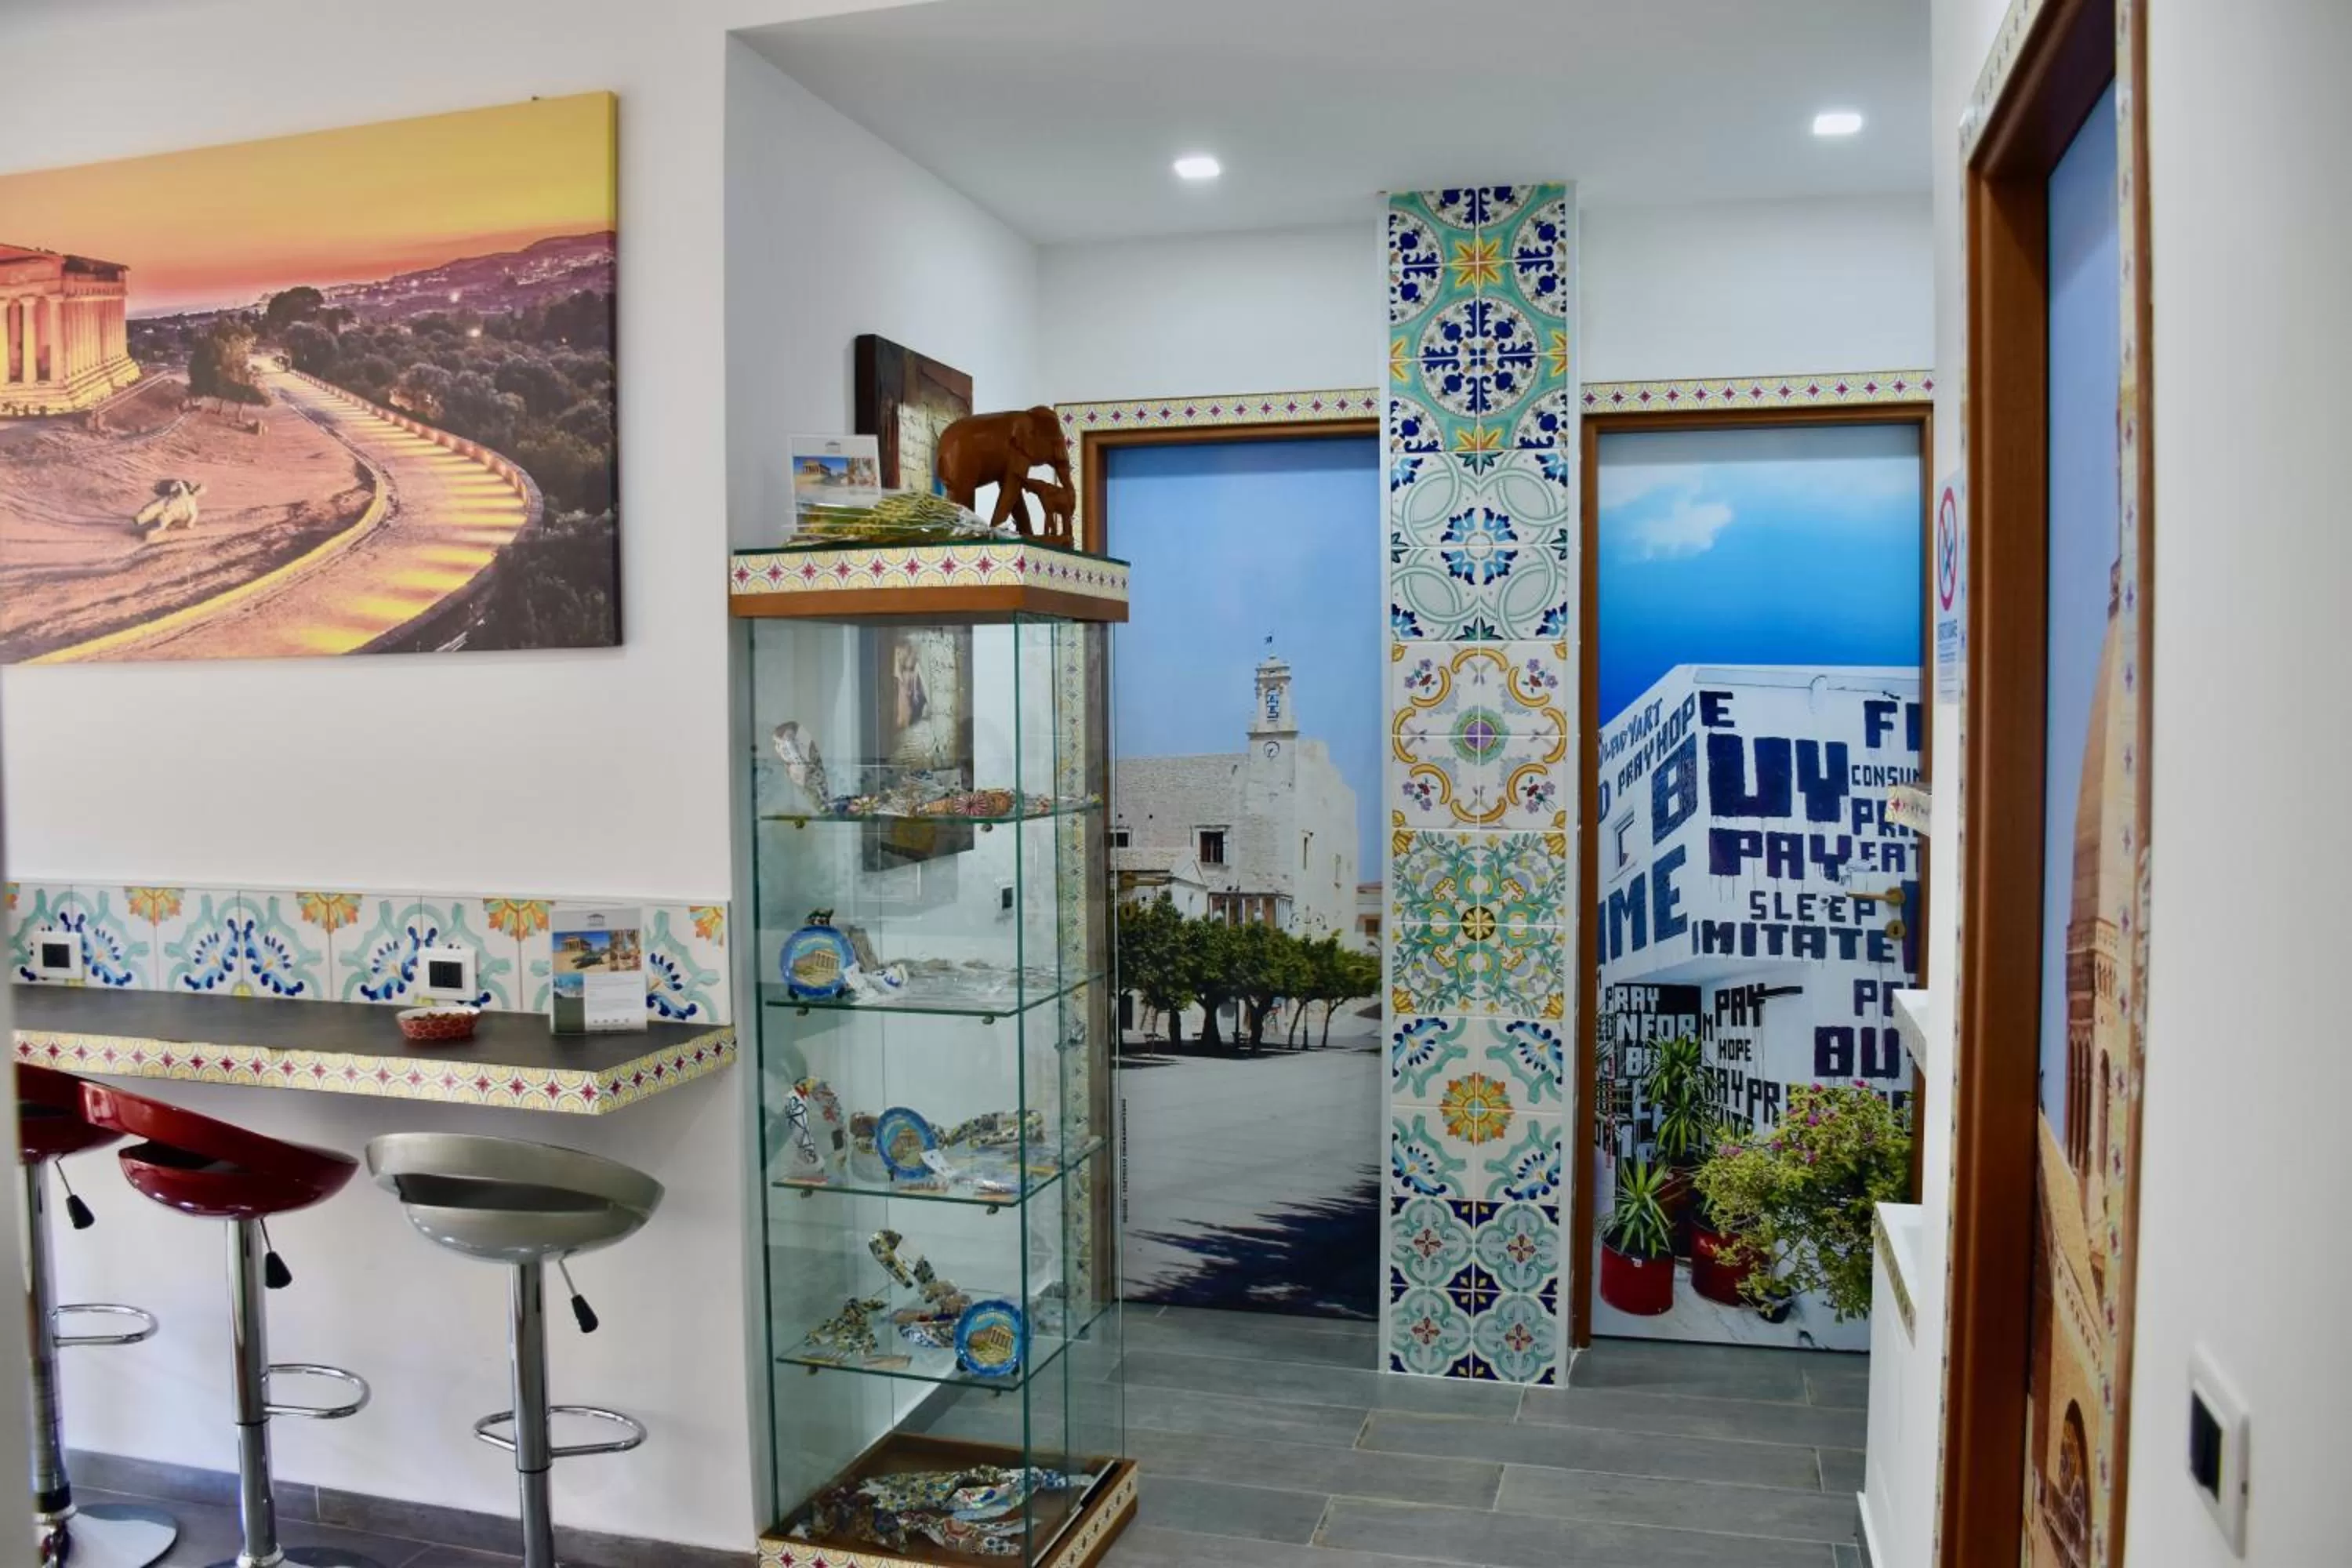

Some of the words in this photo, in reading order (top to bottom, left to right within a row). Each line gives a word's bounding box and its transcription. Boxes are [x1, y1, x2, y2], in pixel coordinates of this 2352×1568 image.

[1709, 827, 1852, 882] PAY
[1750, 891, 1875, 925] SLEEP
[1692, 919, 1896, 963] IMITATE
[1715, 982, 1766, 1028] PAY
[1719, 1038, 1752, 1062] HOPE
[1814, 1025, 1911, 1079] BU
